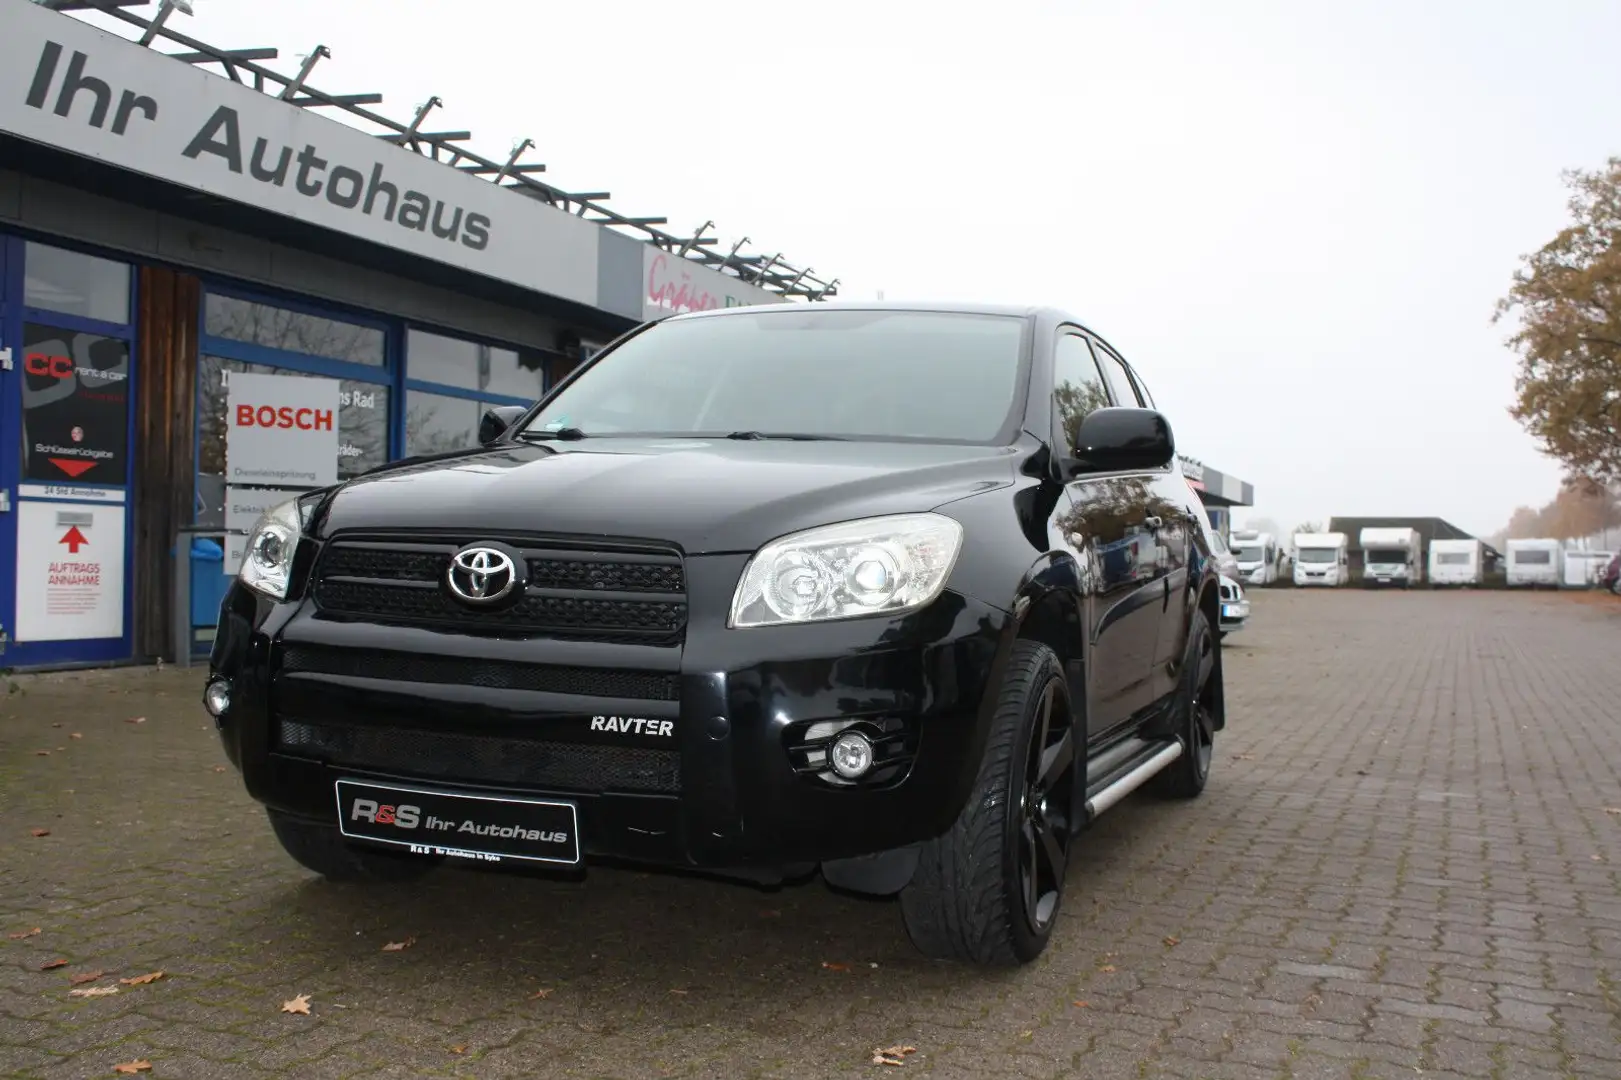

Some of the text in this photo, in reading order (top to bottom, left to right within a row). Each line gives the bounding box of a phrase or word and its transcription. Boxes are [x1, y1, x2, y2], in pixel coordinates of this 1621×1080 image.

[25, 41, 492, 251] Ihr Autohaus
[353, 390, 375, 409] Rad
[236, 404, 333, 431] BOSCH
[48, 562, 100, 574] AUFTRAGS
[48, 575, 100, 586] ANNAHME
[351, 797, 568, 844] R&S Ihr Autohaus
